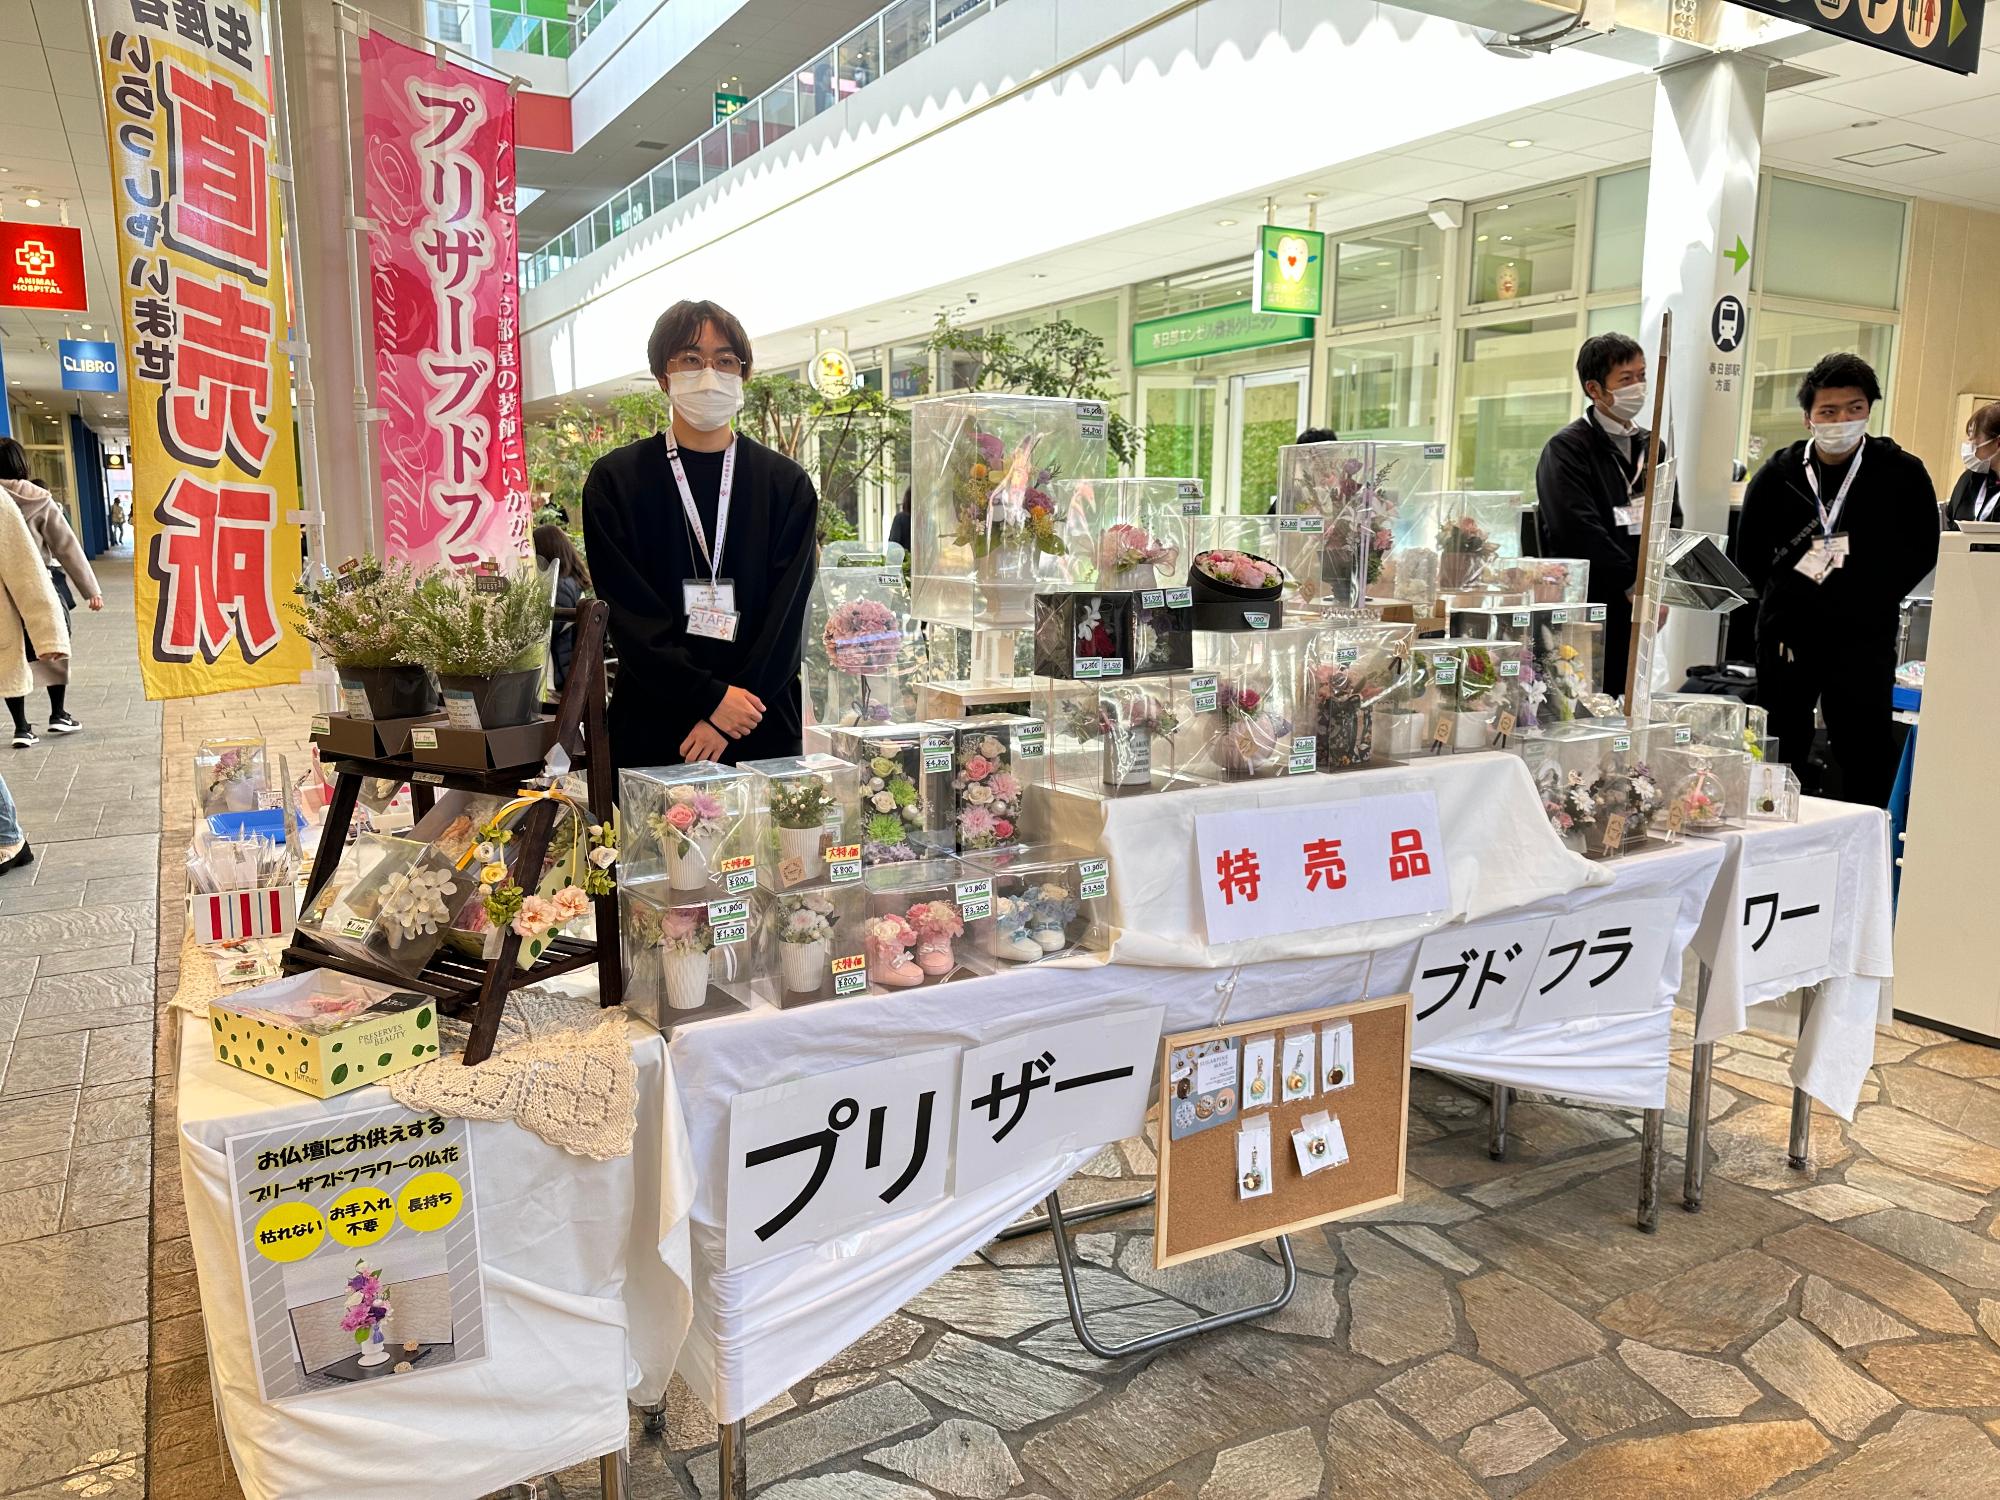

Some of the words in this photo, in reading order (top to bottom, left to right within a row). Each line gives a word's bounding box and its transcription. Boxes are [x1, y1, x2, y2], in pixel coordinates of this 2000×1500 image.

[13, 284, 63, 294] HOSPITAL
[17, 276, 58, 287] ANIMAL
[1709, 361, 1741, 376] 春日部駅
[1715, 378, 1732, 392] 方面
[690, 610, 733, 627] STAFF
[829, 848, 859, 860] 大特価
[723, 858, 752, 871] 大特価
[833, 865, 854, 876] ¥800
[1216, 828, 1432, 906] 特売品
[729, 876, 749, 887] ¥800
[717, 927, 745, 939] ¥1,300
[834, 957, 863, 971] 大特価
[837, 975, 858, 987] ¥800
[359, 1024, 403, 1044] PRESERVES
[374, 1029, 406, 1047] BEAUTY
[257, 1116, 446, 1171] お仏壇にお供えする
[248, 1146, 460, 1203] プリーザブドフラワーの仏花
[330, 1197, 393, 1222] お手入れ
[407, 1190, 453, 1214] 長持ち
[260, 1220, 323, 1245] 枯れない
[346, 1217, 379, 1237] 不要
